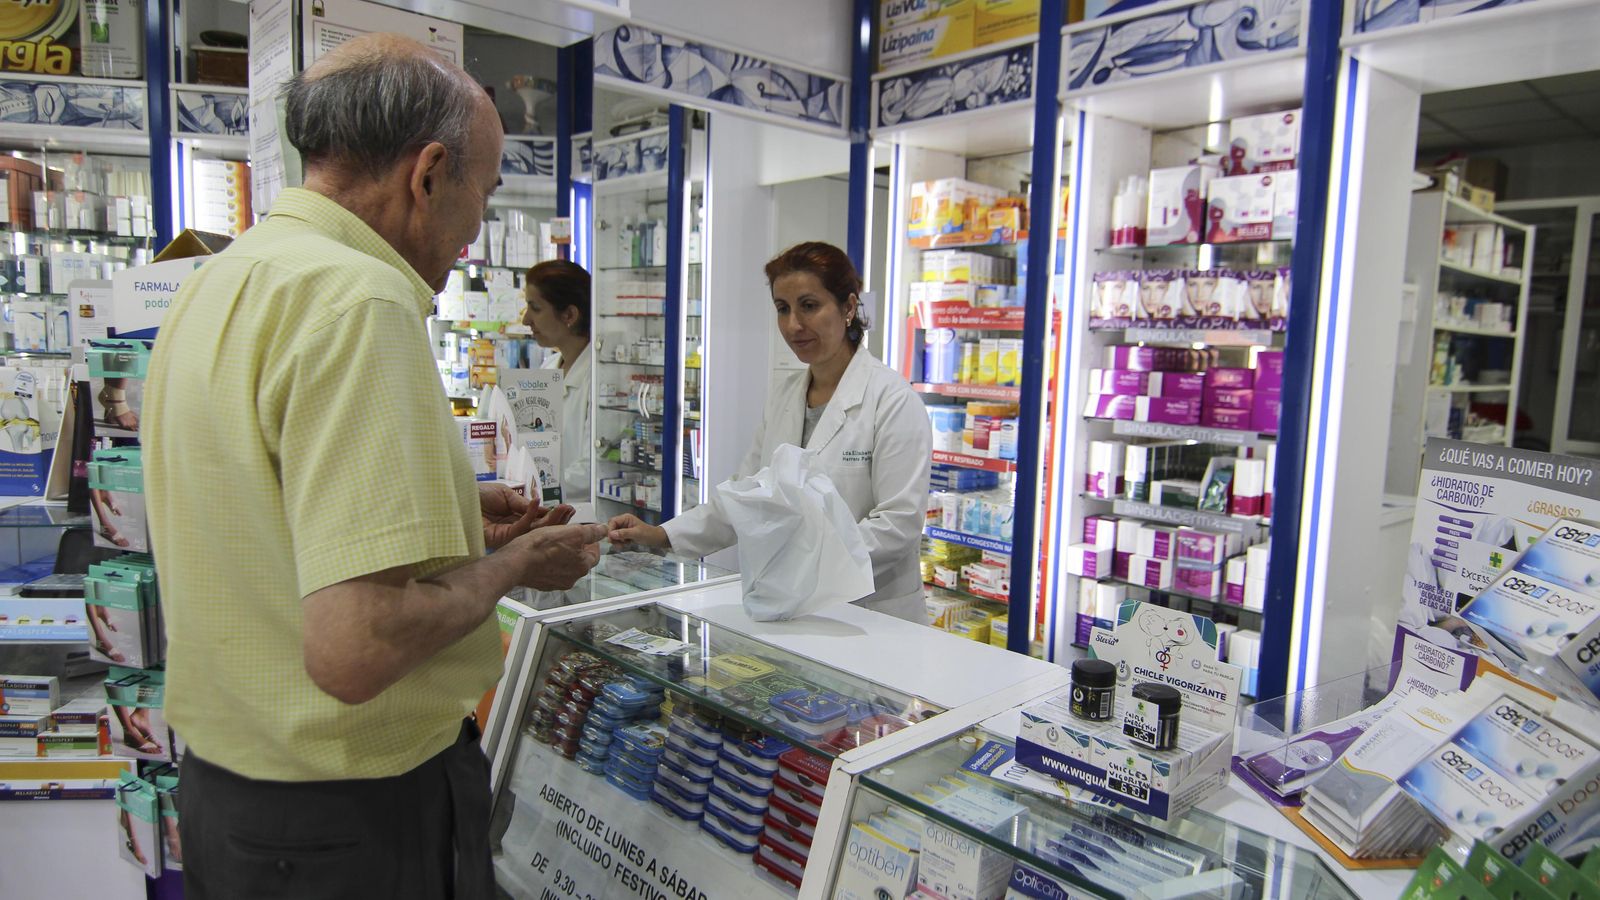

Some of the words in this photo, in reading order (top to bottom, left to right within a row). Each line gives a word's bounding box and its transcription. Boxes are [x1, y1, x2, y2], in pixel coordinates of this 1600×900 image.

[882, 26, 935, 54] Lizipaina
[1237, 226, 1267, 237] BELLEZA
[517, 380, 548, 390] Yobalex
[1439, 448, 1470, 465] ¿QUÉ
[1472, 452, 1494, 470] VAS
[1496, 456, 1505, 472] A
[1508, 457, 1554, 480] COMER
[1556, 465, 1593, 487] HOY?
[1431, 475, 1479, 496] ¿HIDRATOS
[1482, 484, 1495, 498] DE
[1436, 488, 1485, 508] CARBONO?
[932, 529, 961, 541] GARGANTA
[1555, 526, 1591, 544] CB12
[1418, 581, 1437, 593] SOBRE
[1420, 590, 1446, 605] BLOQUEA
[1502, 576, 1537, 595] CB12
[1546, 590, 1594, 616] boost
[1419, 597, 1427, 606] DE
[1427, 600, 1439, 610] LAS
[1095, 634, 1116, 646] Stevia
[1414, 642, 1447, 662] ¿HIDRATOS
[1446, 655, 1456, 666] DE
[1417, 651, 1450, 671] CARBONO?
[1134, 666, 1164, 682] CHICLE
[1166, 675, 1227, 701] VIGORIZANTE
[1406, 676, 1439, 698] ¿HIDRATOS
[1495, 705, 1529, 727] CB12
[1536, 728, 1585, 761] boost
[1108, 762, 1148, 781] CHICLES
[1441, 750, 1473, 774] CB12
[1479, 776, 1524, 810] boost
[1500, 822, 1543, 859] CB12
[1557, 772, 1600, 816] boo
[539, 783, 586, 824] ABIERTO
[586, 814, 605, 838] DE
[604, 826, 646, 867] LUNES
[646, 858, 657, 878] A
[1543, 825, 1566, 847] Mint
[556, 819, 612, 870] (INCLUIDO
[530, 851, 550, 875] DE
[553, 868, 576, 896] 9.30
[1014, 867, 1064, 900] Opticalm
